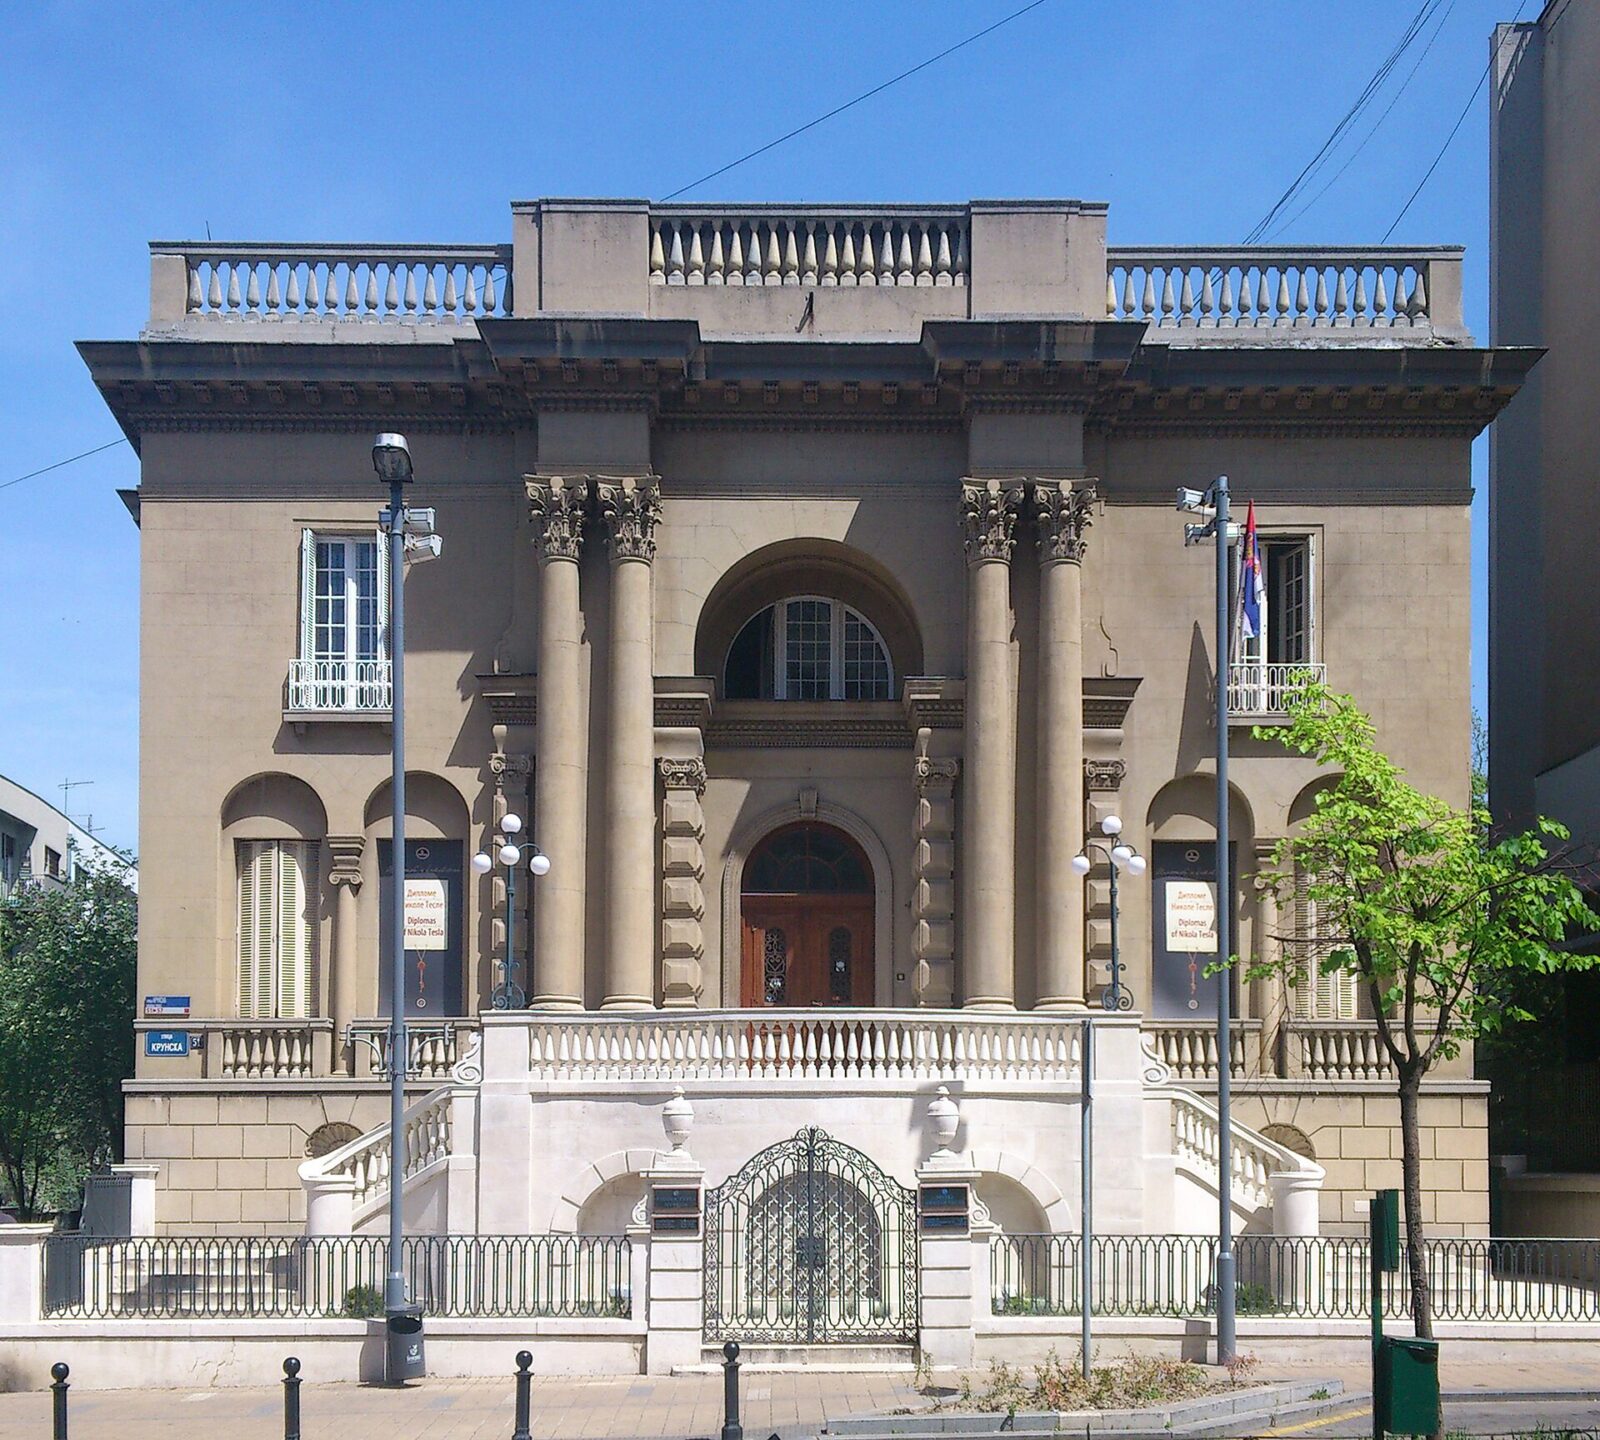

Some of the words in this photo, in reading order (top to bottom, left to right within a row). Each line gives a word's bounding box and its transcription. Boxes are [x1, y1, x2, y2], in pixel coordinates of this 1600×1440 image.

[407, 889, 437, 897] Дипломе
[425, 900, 443, 908] Тесле
[1196, 902, 1214, 911] Тесле
[407, 916, 437, 926] Diplomas
[1178, 918, 1207, 927] Diplomas
[407, 928, 427, 936] Nikola
[428, 928, 444, 936] Tesla
[1171, 930, 1178, 938] of
[1179, 930, 1198, 938] Nikola
[1199, 930, 1214, 938] Tesla
[151, 1042, 183, 1052] КРУНСКА
